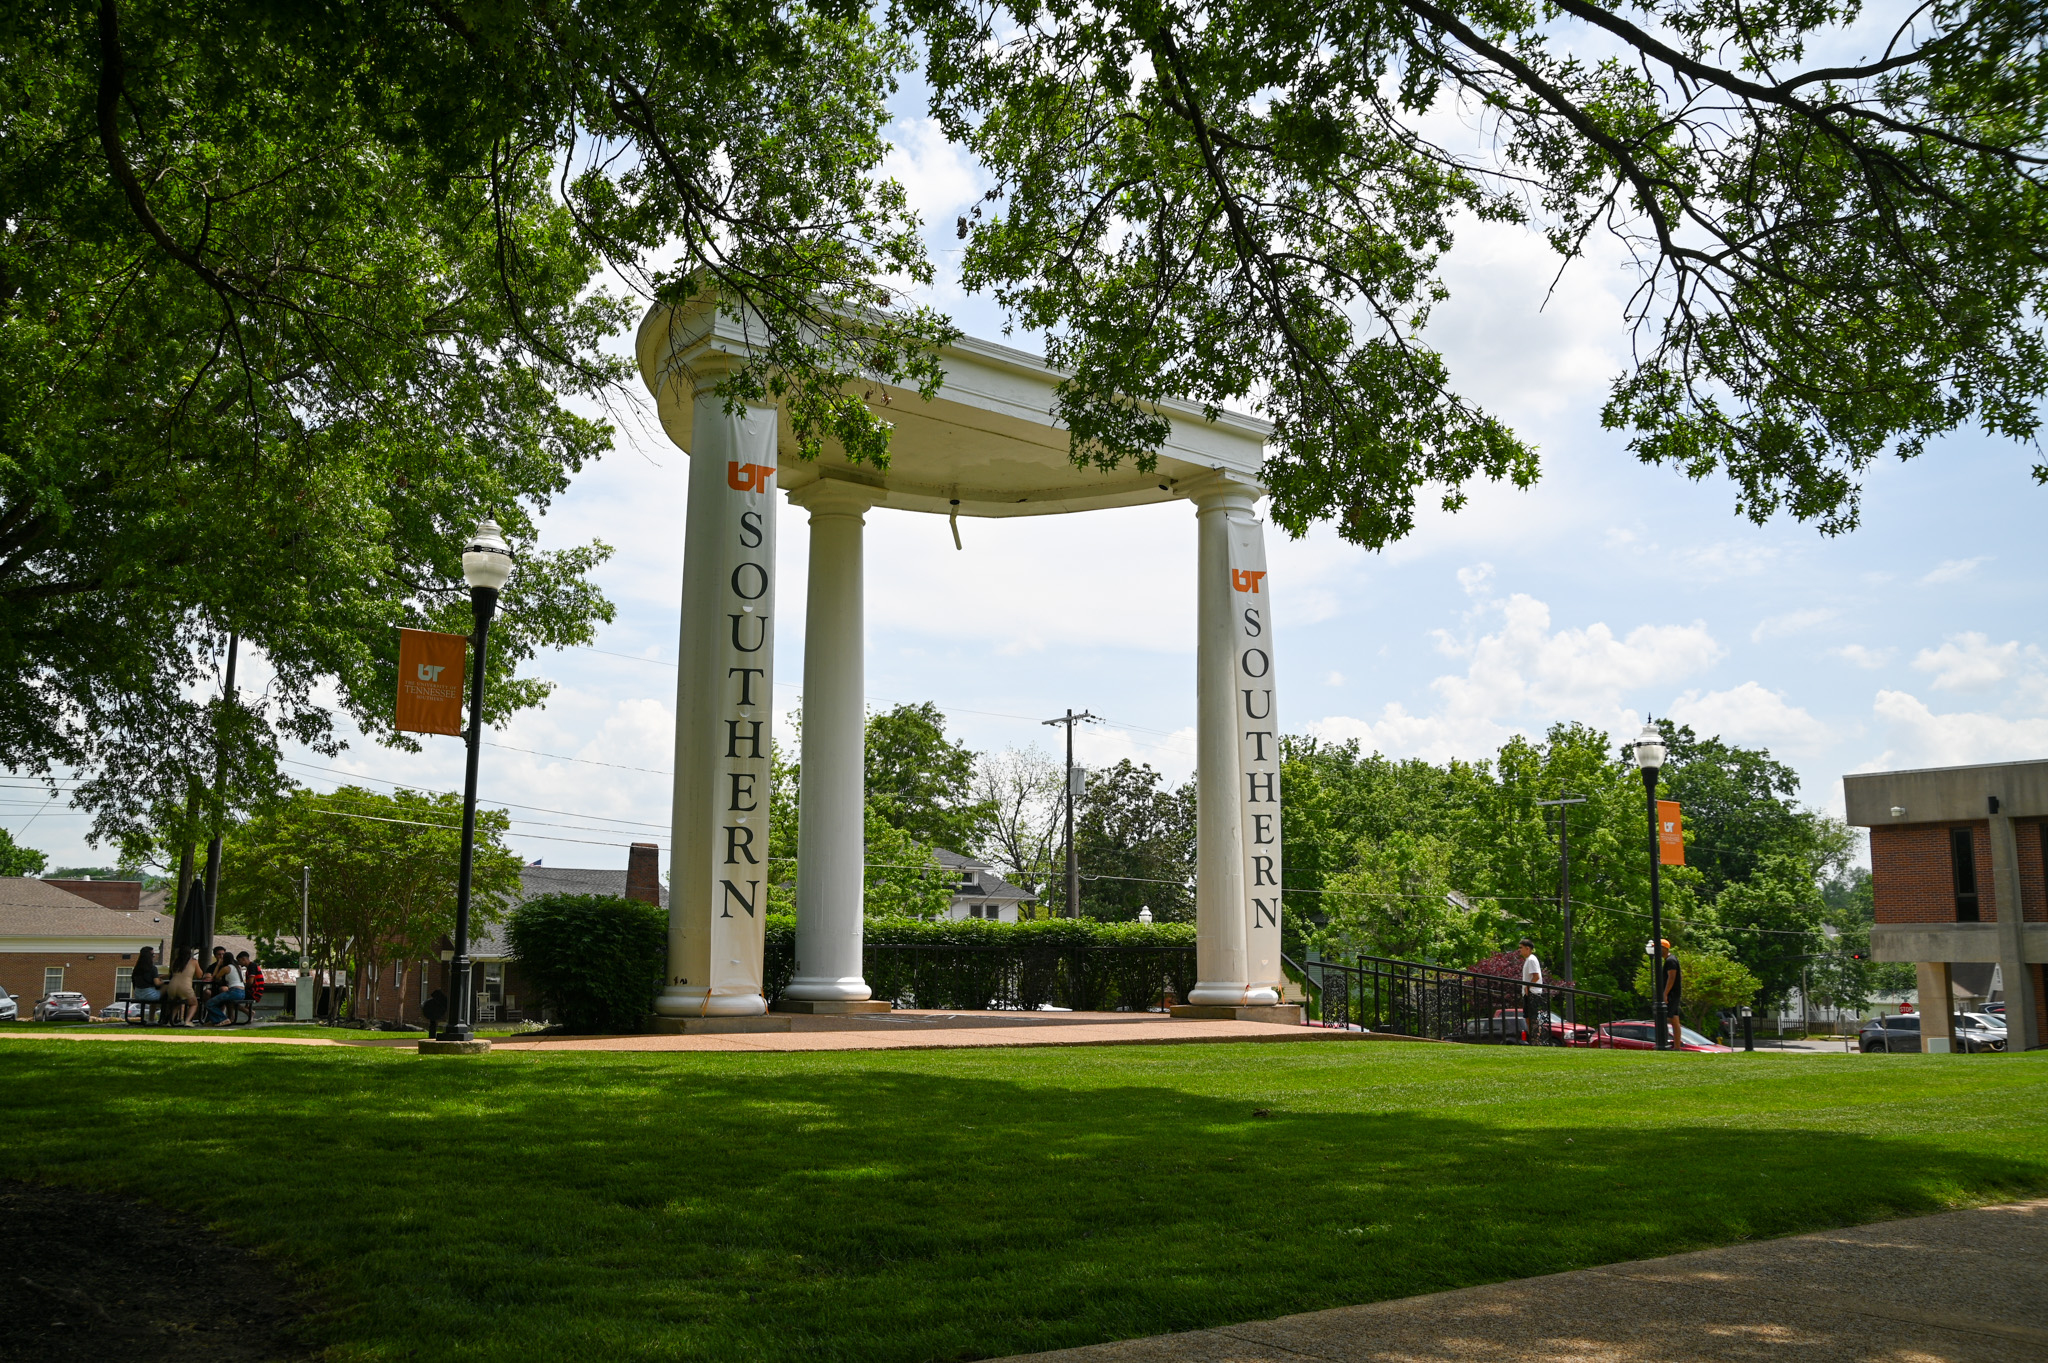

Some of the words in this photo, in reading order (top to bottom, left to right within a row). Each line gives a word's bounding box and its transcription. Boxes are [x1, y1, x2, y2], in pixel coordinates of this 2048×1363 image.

[728, 461, 776, 494] UT
[1232, 568, 1267, 593] UT
[418, 664, 445, 682] UT
[404, 685, 456, 698] TENNESSEE
[720, 511, 769, 919] SOUTHERN
[1241, 608, 1279, 929] SOUTHERN
